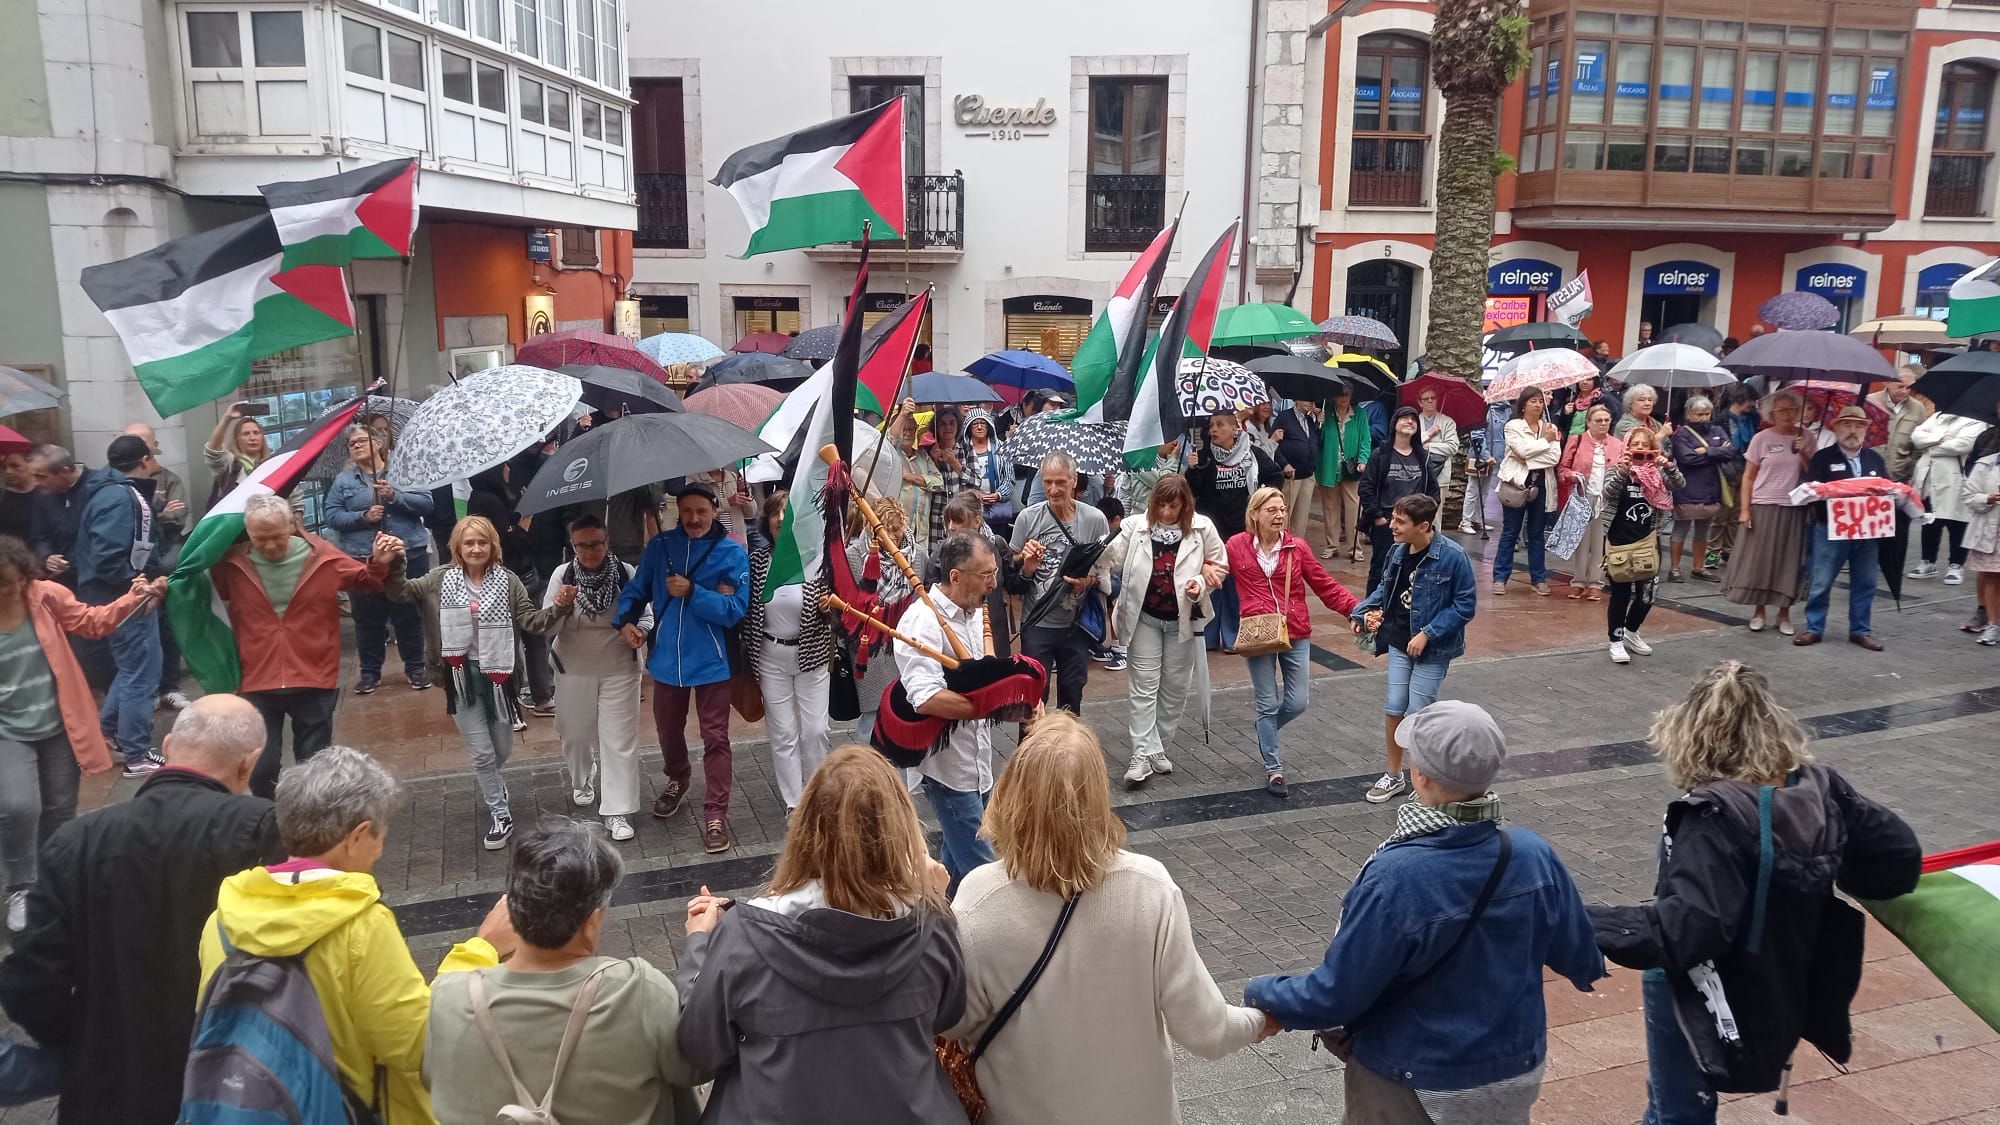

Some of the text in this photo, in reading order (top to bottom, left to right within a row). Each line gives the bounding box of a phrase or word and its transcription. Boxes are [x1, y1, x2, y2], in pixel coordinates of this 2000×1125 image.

[953, 94, 1057, 125] Cuende
[991, 129, 1021, 140] 1910
[1384, 244, 1392, 257] 5
[1499, 269, 1549, 285] reines
[1658, 269, 1706, 286] reines
[1808, 272, 1854, 288] reines
[875, 300, 902, 309] Cuend
[1493, 301, 1527, 310] Caribe
[1484, 311, 1527, 320] exicano
[545, 480, 593, 498] INESIS
[1832, 496, 1892, 524] EURO
